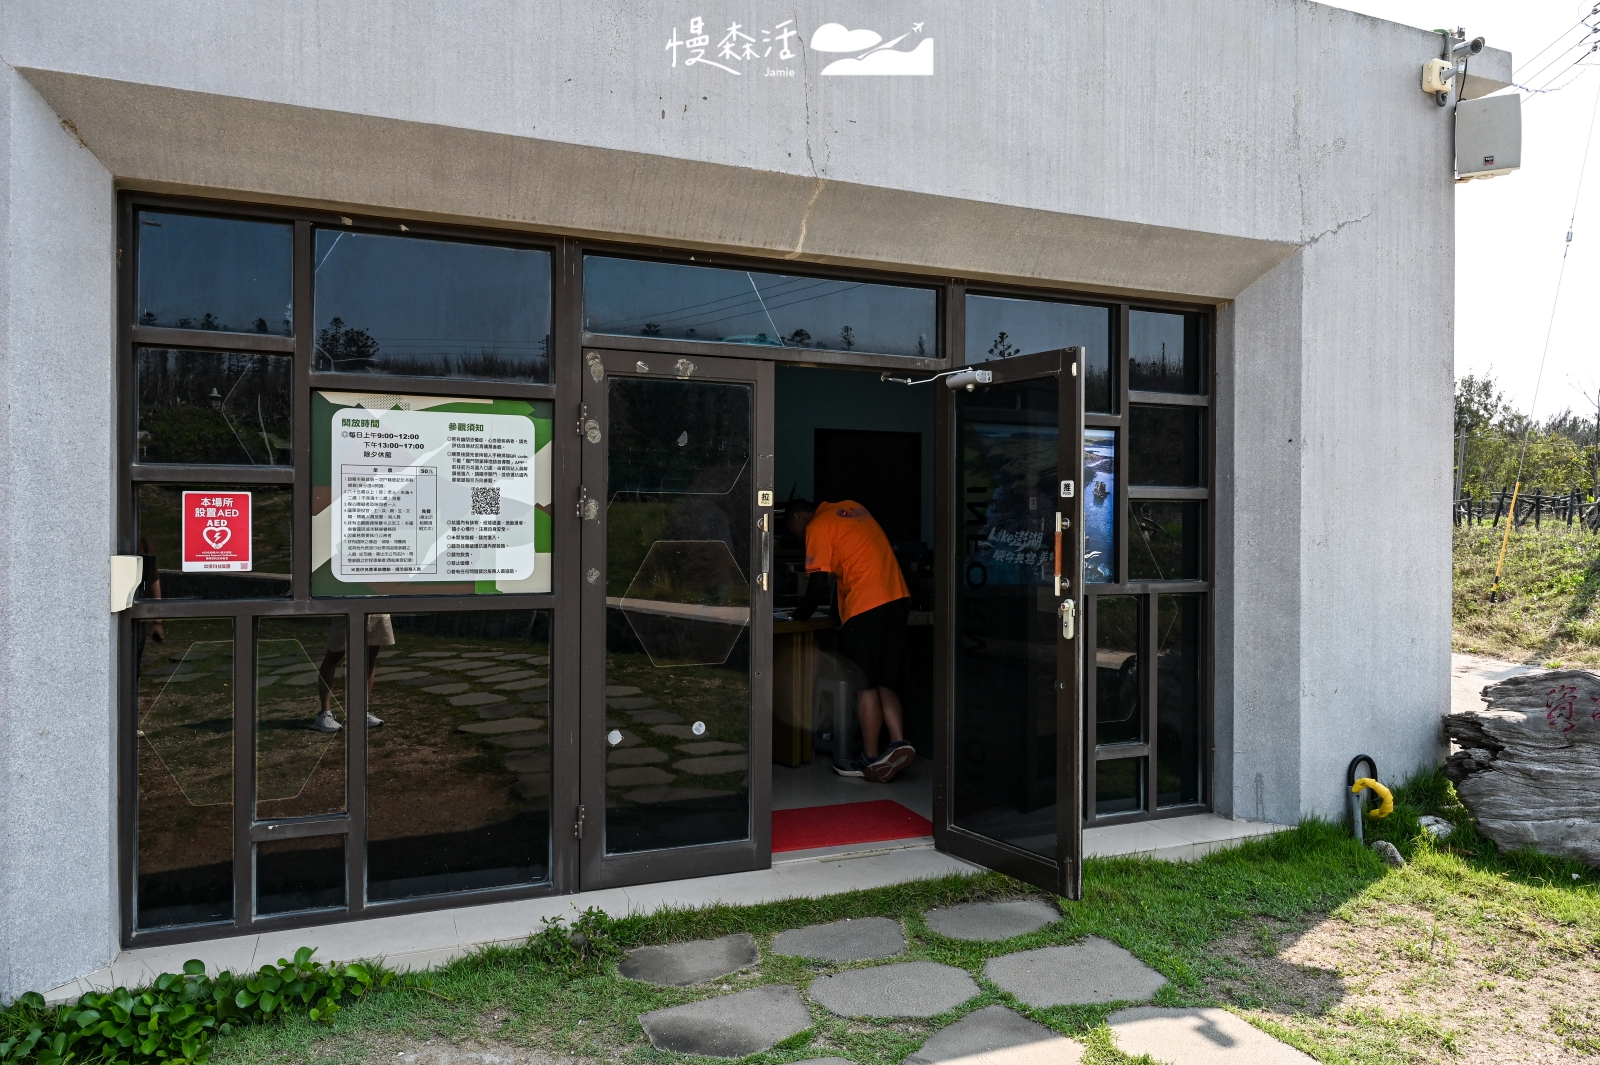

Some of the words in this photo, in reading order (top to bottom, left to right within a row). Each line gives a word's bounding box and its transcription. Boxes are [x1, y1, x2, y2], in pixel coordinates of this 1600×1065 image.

[342, 418, 380, 428] 開放時間
[448, 422, 484, 432] 參觀須知
[1063, 483, 1071, 492] 推
[761, 492, 770, 501] 拉
[200, 497, 234, 507] 本場所
[195, 507, 240, 518] 設置AED
[206, 519, 228, 527] AED
